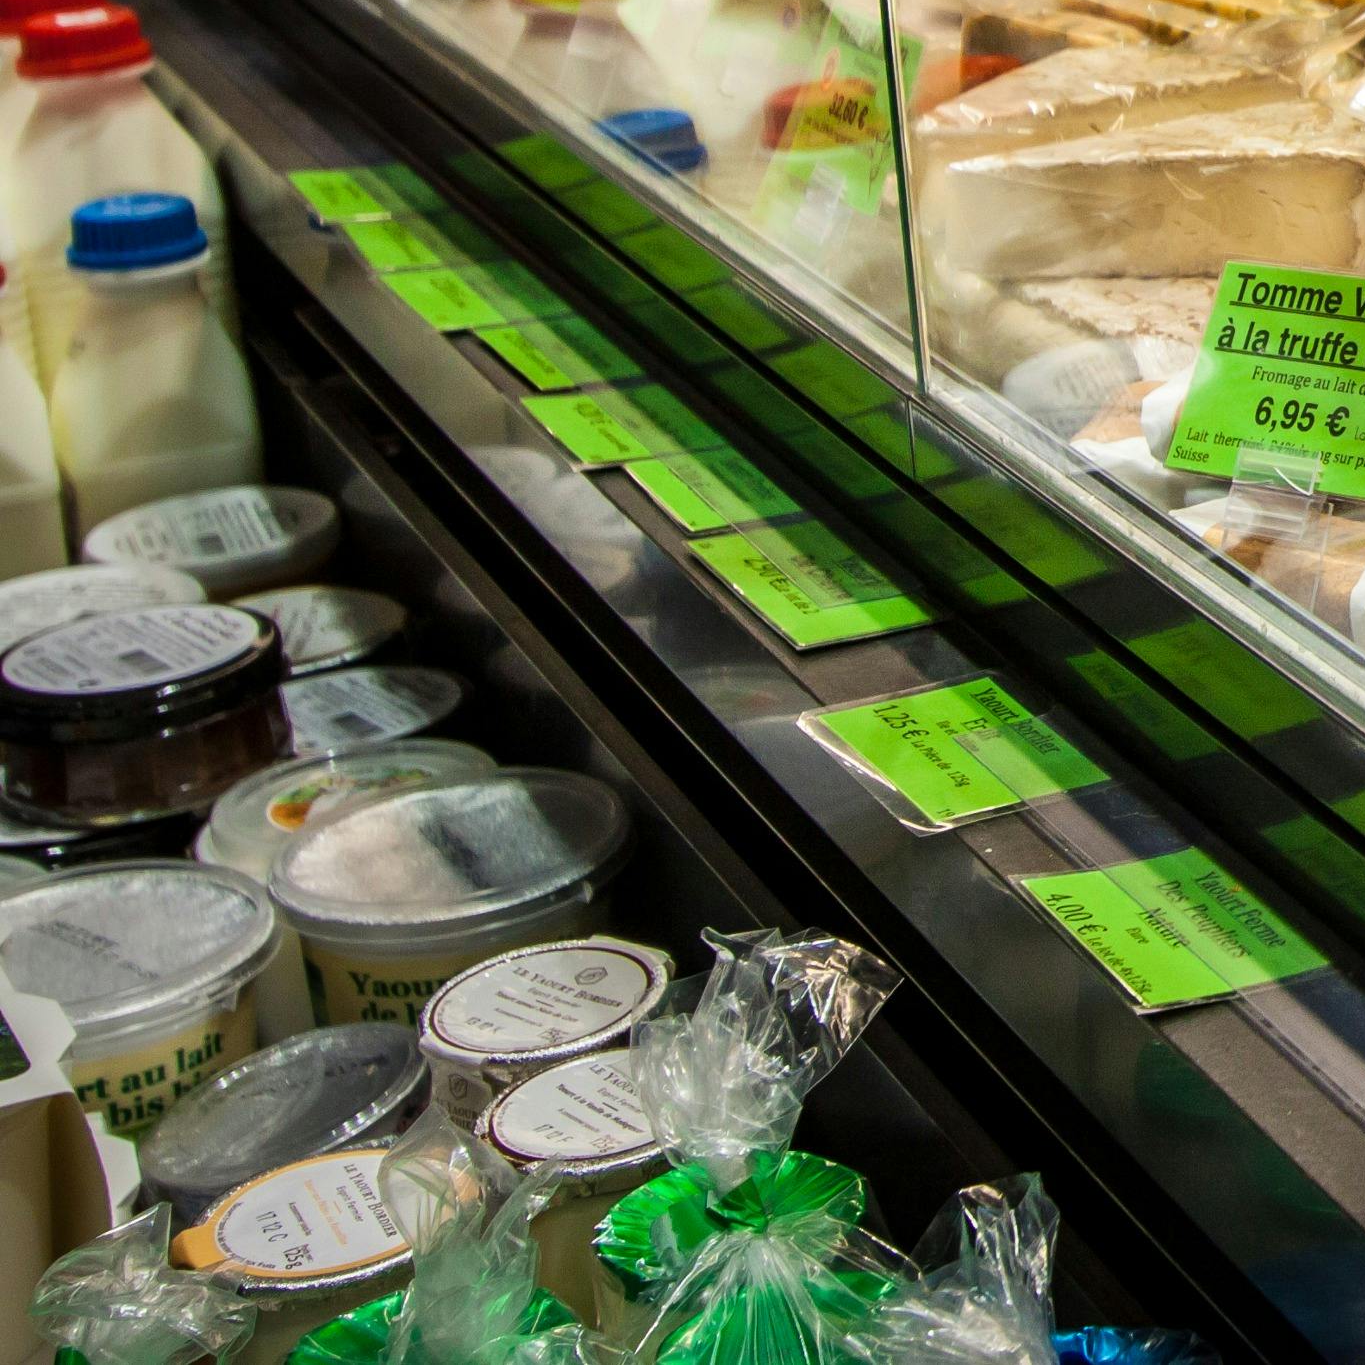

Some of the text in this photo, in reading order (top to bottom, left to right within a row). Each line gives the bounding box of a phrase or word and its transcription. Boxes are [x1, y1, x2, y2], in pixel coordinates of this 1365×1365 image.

[1237, 272, 1343, 314] Tomme
[1217, 317, 1236, 349] à
[1242, 321, 1270, 354] la
[1278, 327, 1358, 365] truffe
[1251, 365, 1312, 391] Fromage
[1313, 376, 1330, 391] au
[1333, 376, 1356, 395] lait
[1254, 396, 1319, 433] 6,95
[1325, 405, 1350, 438] €
[1173, 445, 1210, 463] Suisse
[1186, 426, 1209, 443] Lait
[1333, 452, 1356, 468] sur
[872, 702, 919, 730] 1,25
[902, 728, 931, 741] €
[970, 686, 1019, 723] Yaourt
[1045, 891, 1094, 924] 4,00
[1195, 871, 1243, 919] Yaourt
[121, 1032, 221, 1094] au lait
